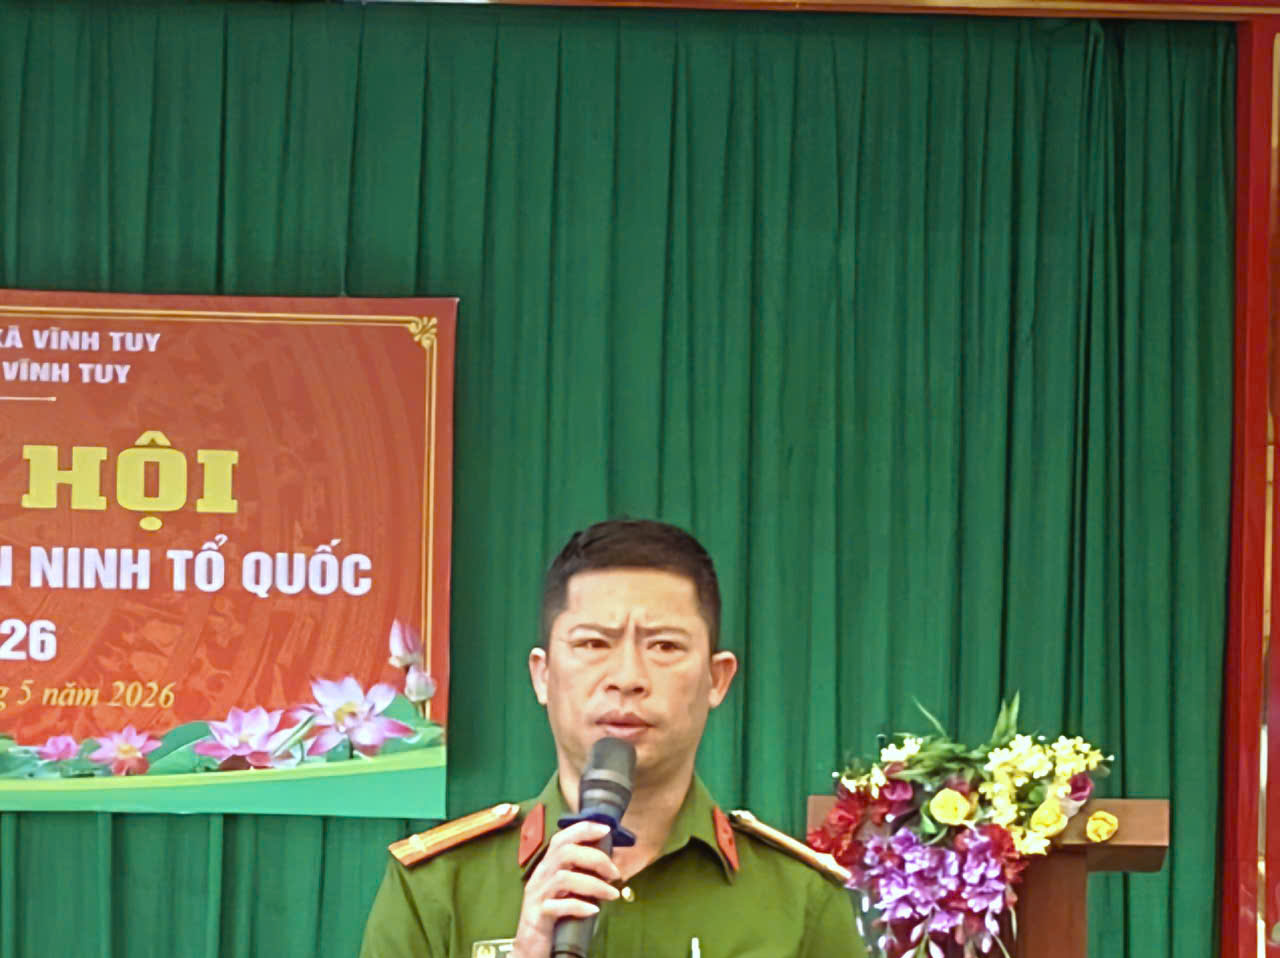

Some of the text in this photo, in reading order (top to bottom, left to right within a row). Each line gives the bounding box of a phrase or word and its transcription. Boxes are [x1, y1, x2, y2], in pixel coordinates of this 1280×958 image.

[32, 327, 100, 350] VĨNH
[109, 332, 161, 352] TUY
[2, 358, 70, 382] VĨNH
[78, 363, 131, 384] TUY
[21, 430, 239, 531] HỘI
[30, 546, 151, 590] NINH
[167, 534, 228, 593] TỔ
[242, 538, 372, 598] QUỐC
[17, 679, 34, 705] 5
[42, 682, 100, 707] năm
[107, 681, 177, 709] 2026
